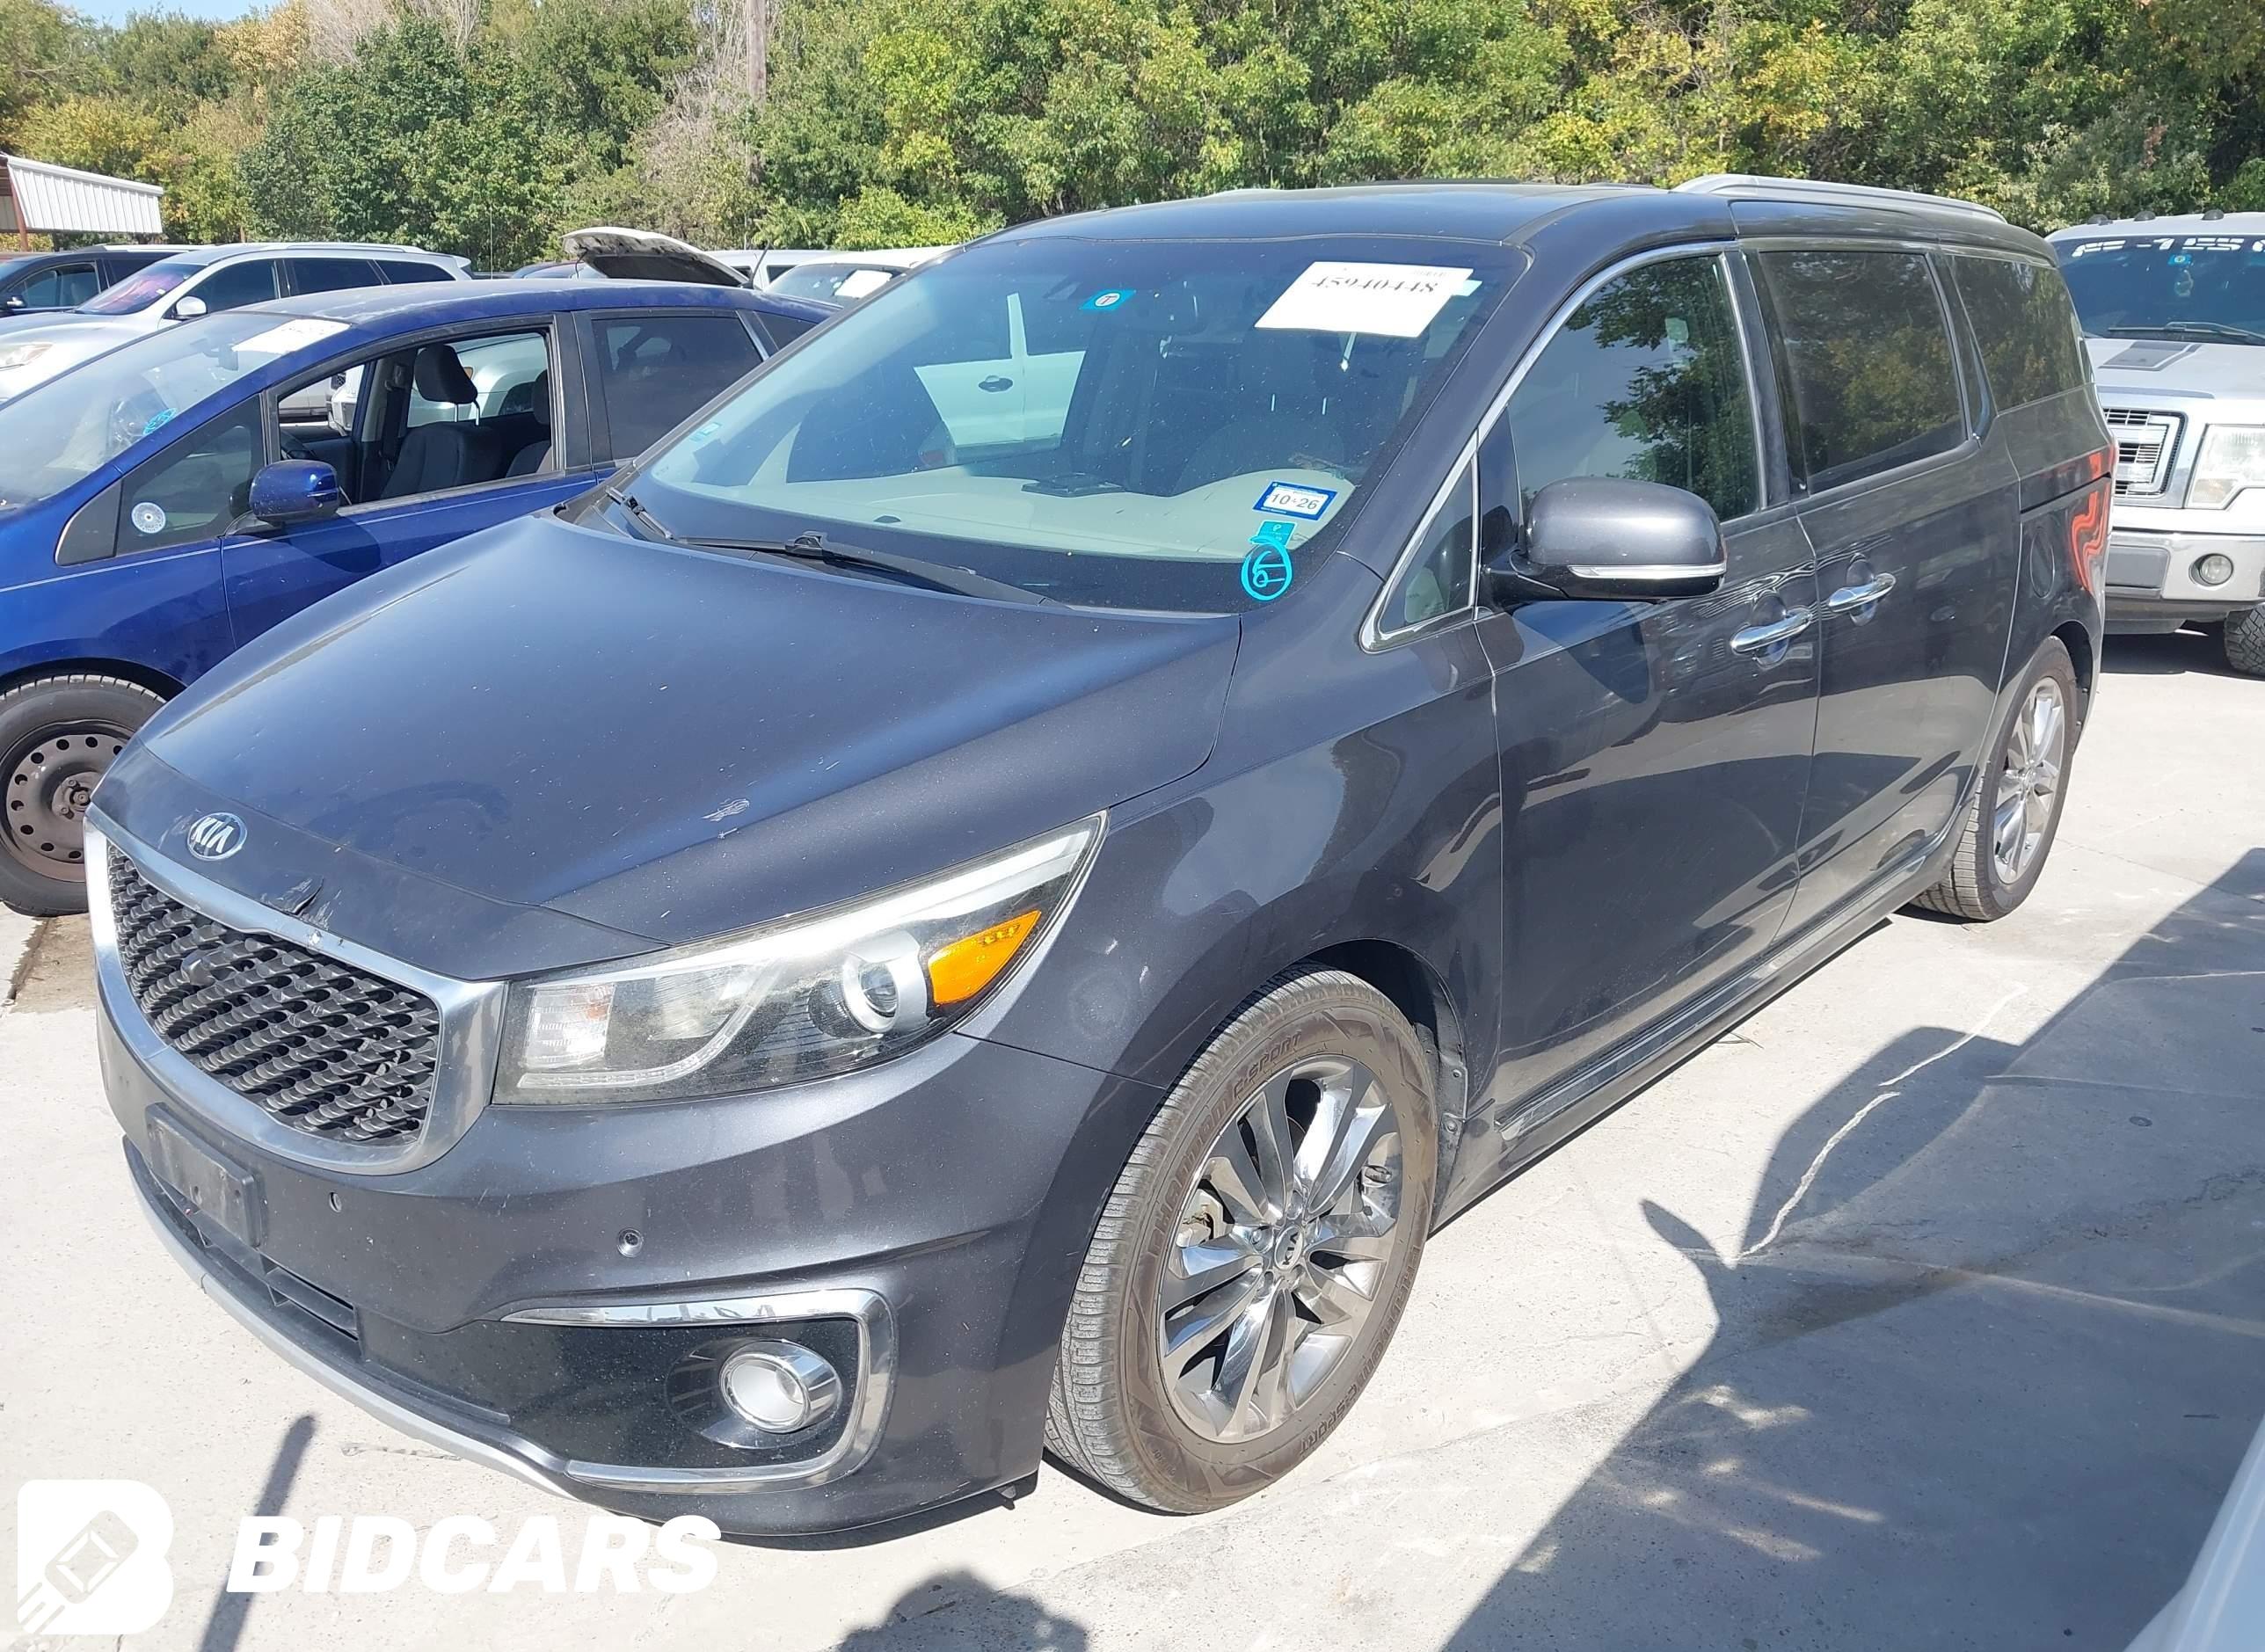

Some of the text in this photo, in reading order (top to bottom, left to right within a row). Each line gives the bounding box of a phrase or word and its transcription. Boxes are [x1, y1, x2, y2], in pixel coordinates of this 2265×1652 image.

[2072, 237, 2265, 258] F-15
[190, 817, 235, 854] KIA
[1282, 1232, 1299, 1265] KIA
